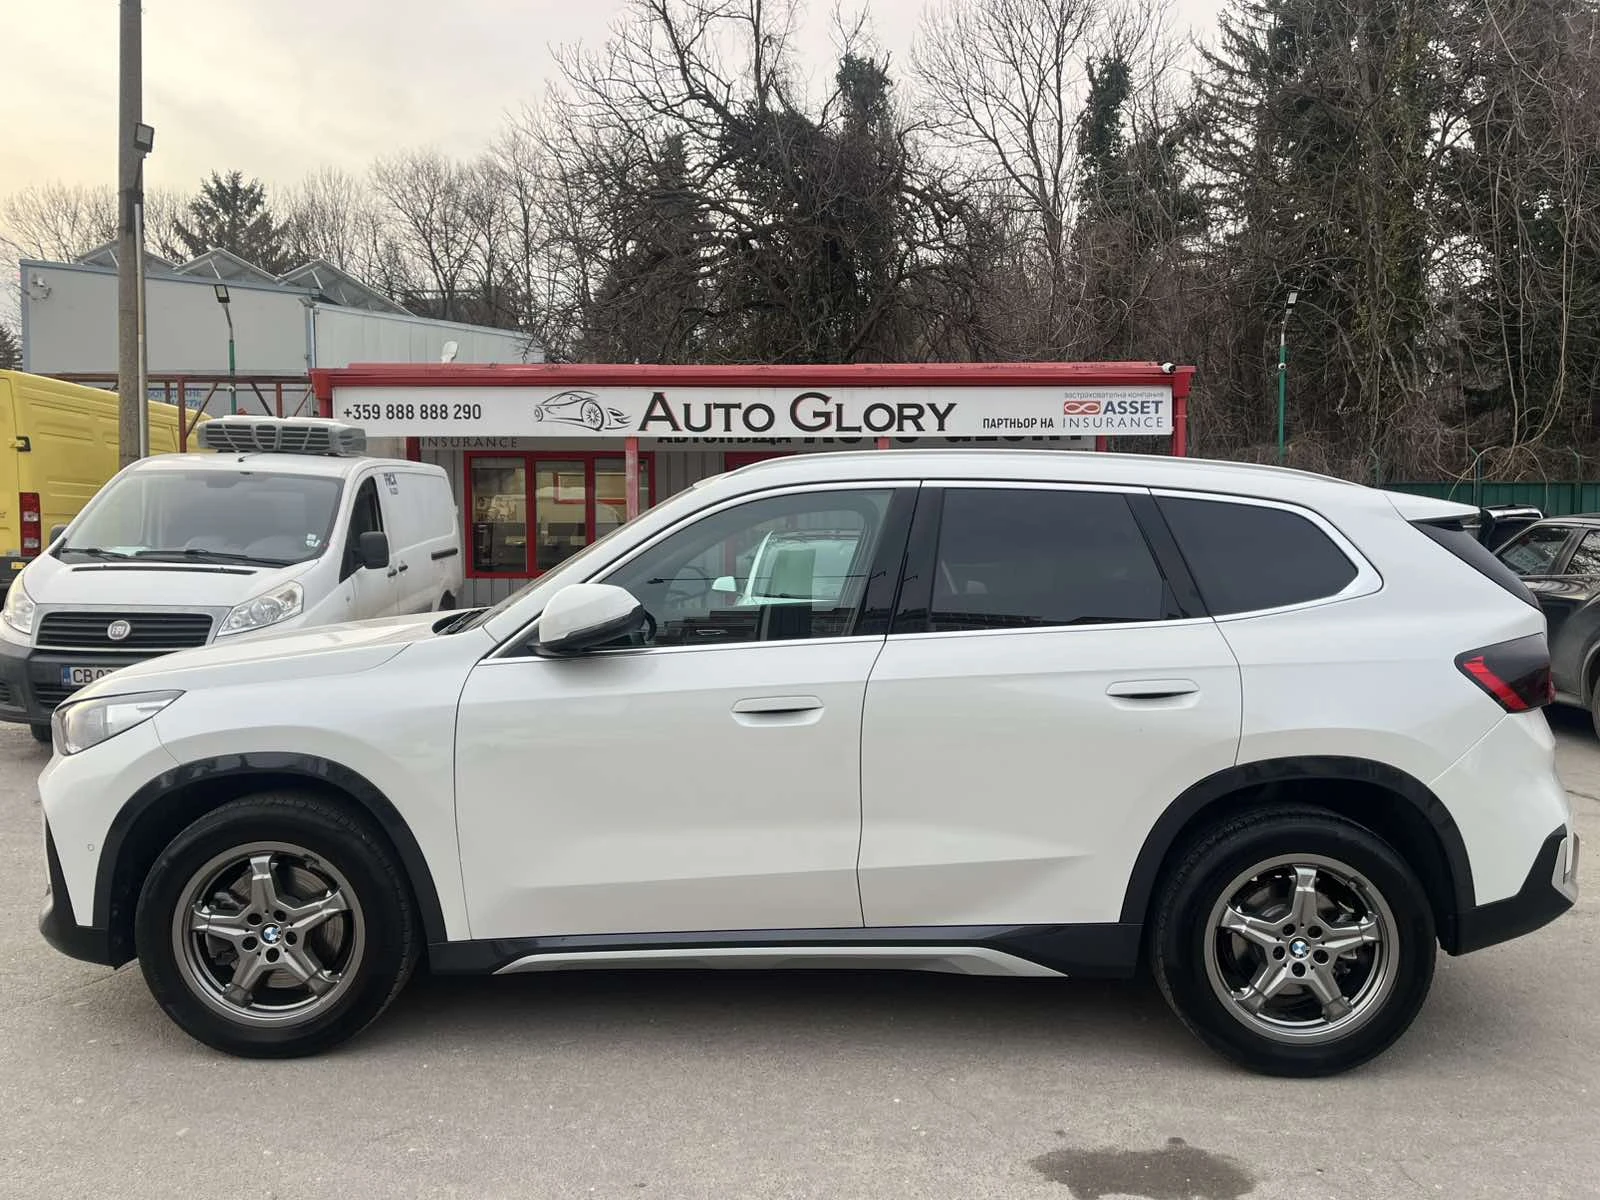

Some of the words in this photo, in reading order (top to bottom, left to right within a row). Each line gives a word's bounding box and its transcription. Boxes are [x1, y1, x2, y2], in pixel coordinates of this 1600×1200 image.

[343, 403, 381, 420] +359
[386, 403, 415, 420] 888
[420, 403, 449, 420] 888
[453, 403, 482, 420] 290
[638, 391, 775, 432] AUTO
[790, 391, 957, 433] GLORY
[1103, 400, 1163, 415] ASSET
[983, 417, 1037, 429] ПАРТНЬОР
[1040, 417, 1054, 429] НА
[1063, 416, 1164, 428] INSURANCE
[421, 436, 518, 449] INSURANCE
